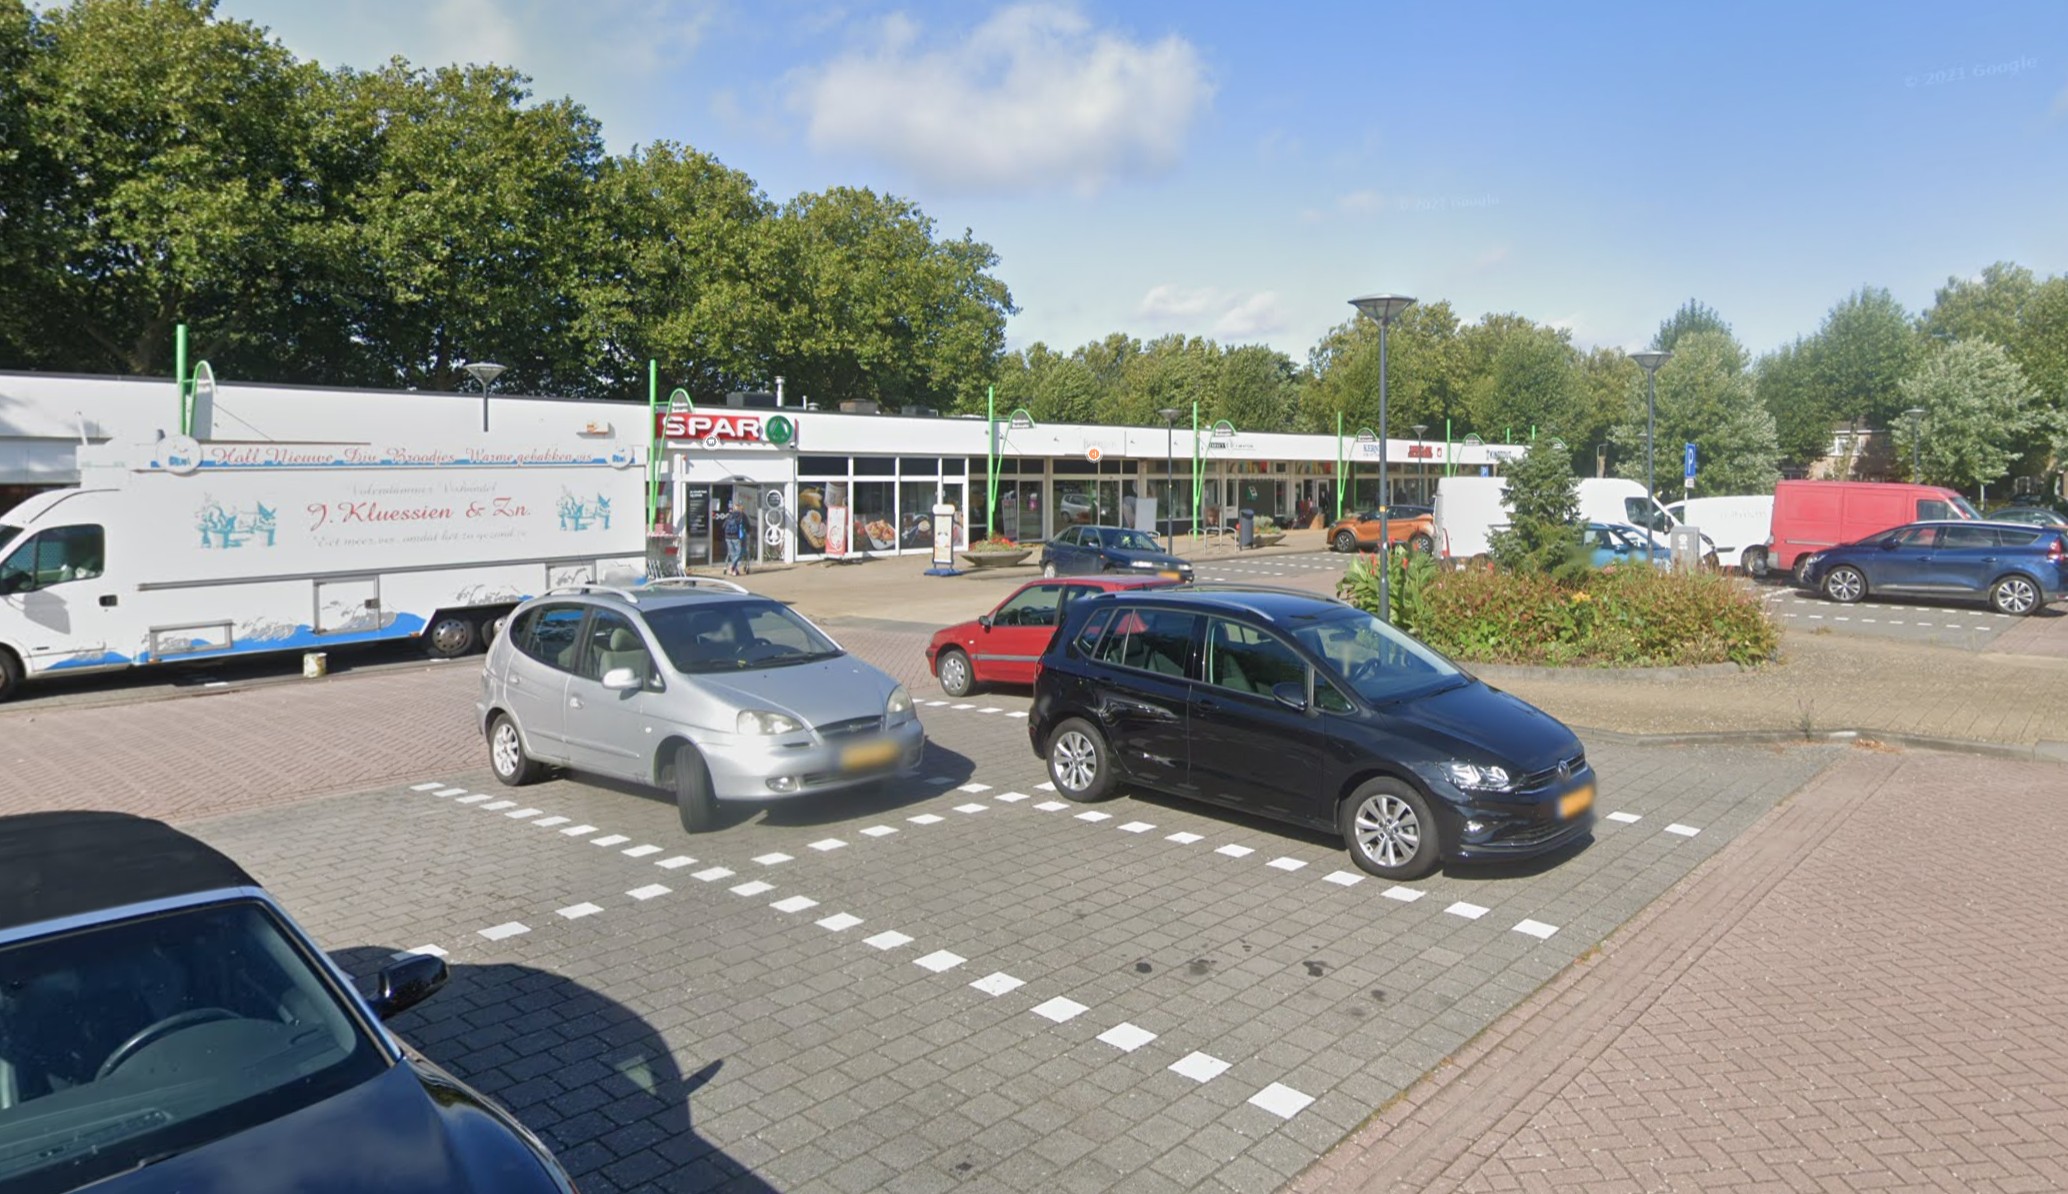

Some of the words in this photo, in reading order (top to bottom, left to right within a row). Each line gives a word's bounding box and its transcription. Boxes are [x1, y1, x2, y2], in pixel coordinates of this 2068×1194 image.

[662, 416, 760, 438] SPAR
[266, 447, 334, 464] Nieuwe
[386, 447, 455, 468] Broodjes
[465, 447, 514, 463] Warme
[516, 447, 573, 468] gebakken
[338, 501, 454, 523] Kluessien
[465, 500, 486, 518] &
[492, 496, 532, 518] Zn.
